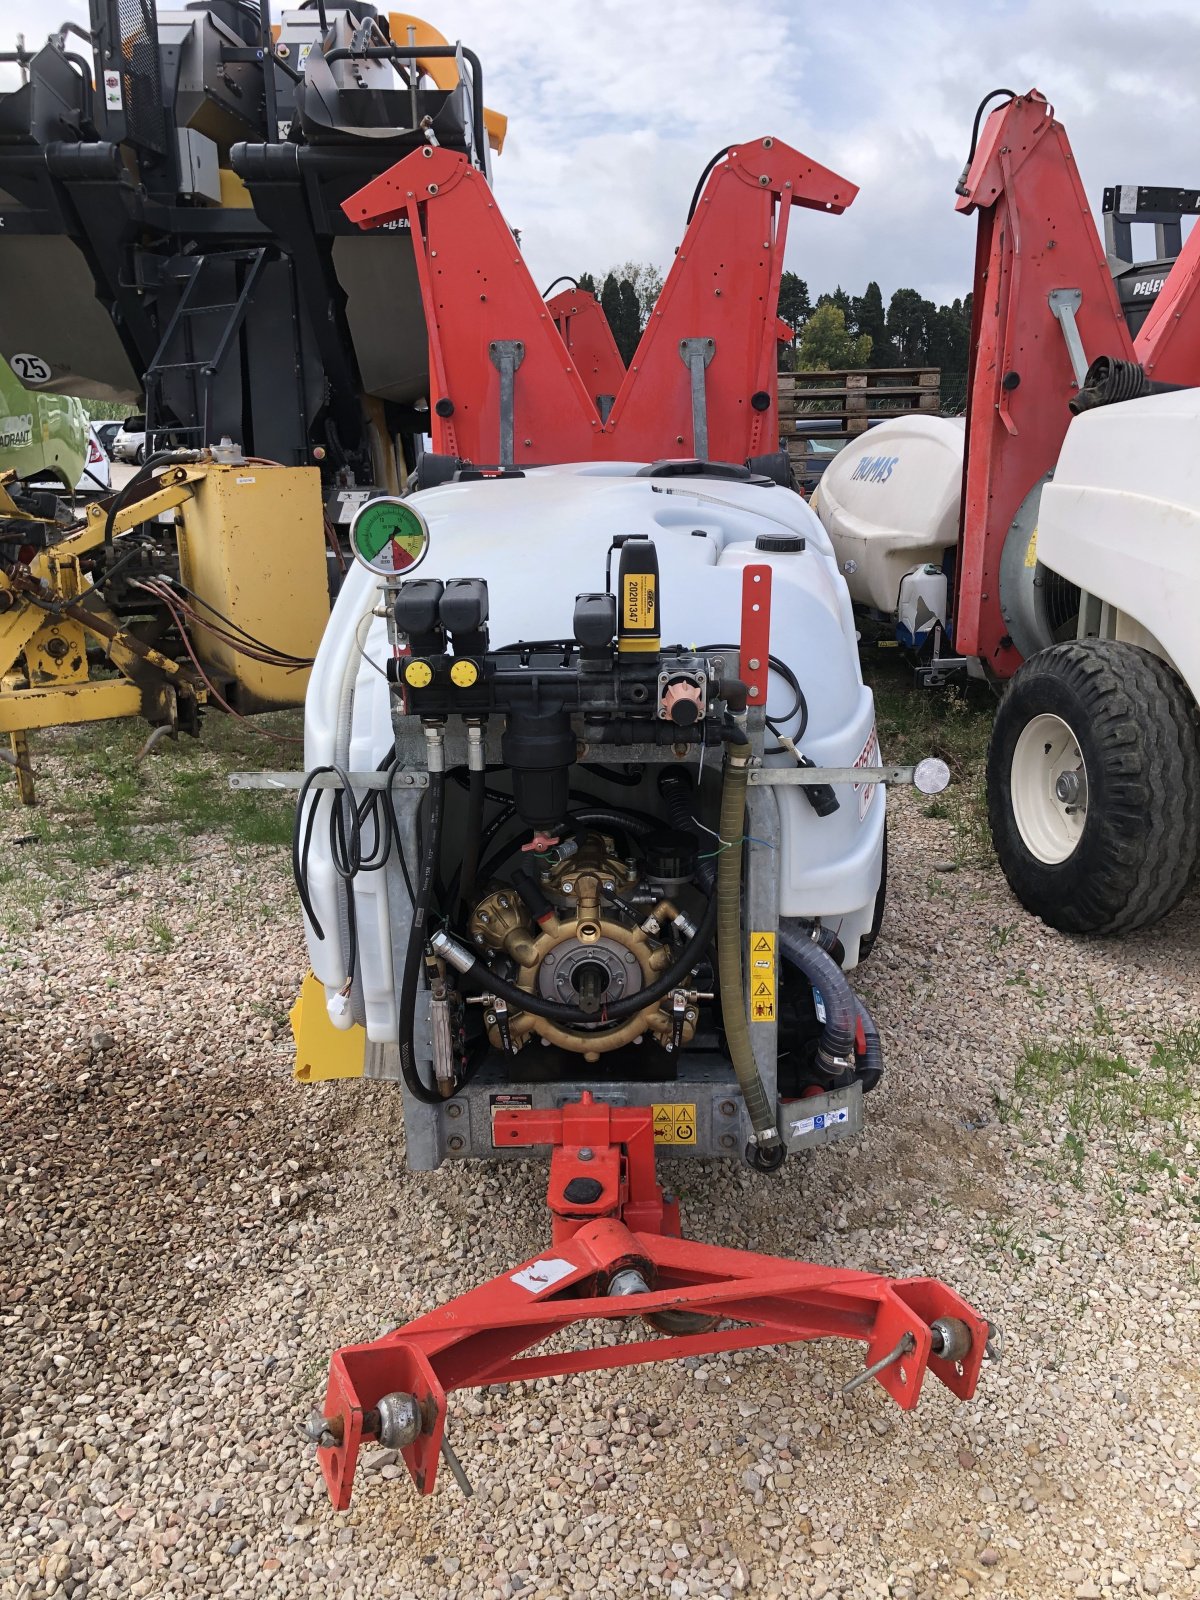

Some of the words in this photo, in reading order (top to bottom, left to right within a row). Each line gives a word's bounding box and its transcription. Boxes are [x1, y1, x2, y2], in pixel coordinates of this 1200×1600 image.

[1133, 279, 1165, 296] PELLEN
[15, 357, 47, 379] 25
[850, 456, 899, 483] THOMAS
[629, 581, 638, 623] 20201347
